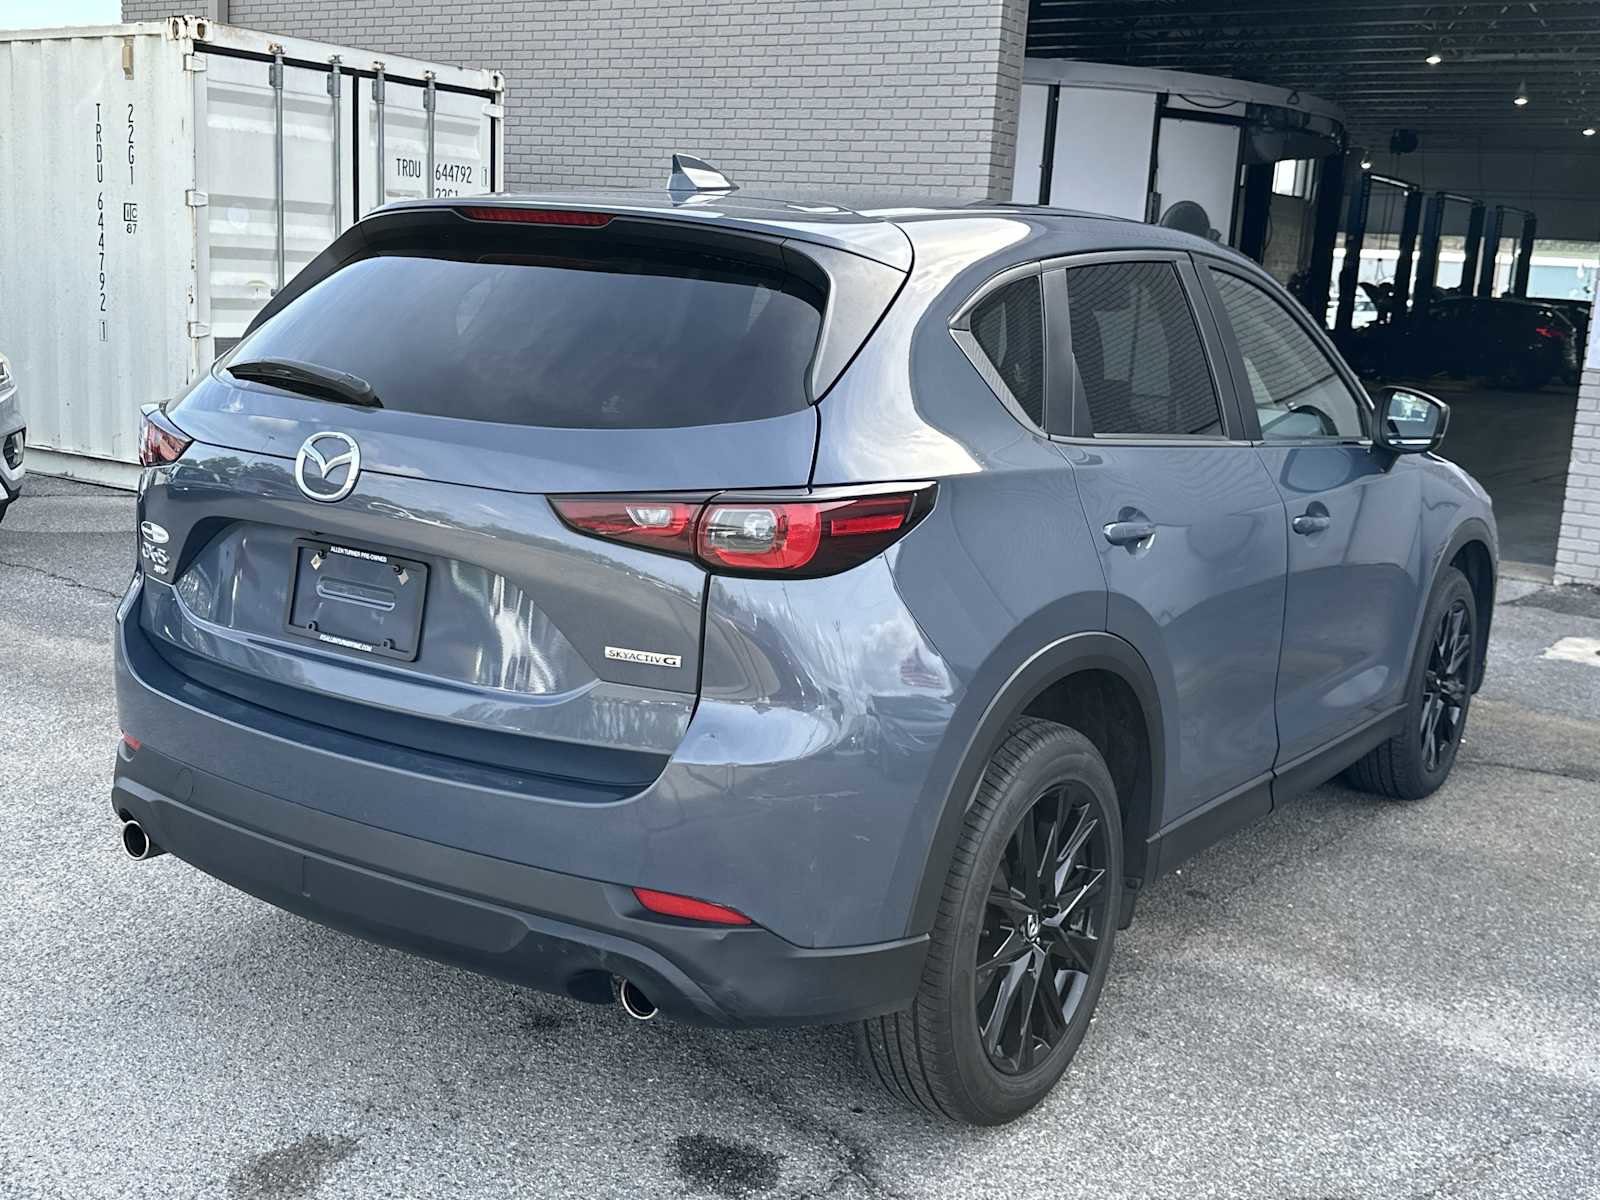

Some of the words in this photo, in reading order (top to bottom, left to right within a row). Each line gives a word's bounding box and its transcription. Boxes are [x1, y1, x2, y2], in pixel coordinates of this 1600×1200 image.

[127, 103, 135, 185] 22G1
[396, 158, 421, 178] TRDU
[435, 163, 472, 184] 644792
[97, 191, 106, 312] 644792
[126, 223, 137, 234] 87
